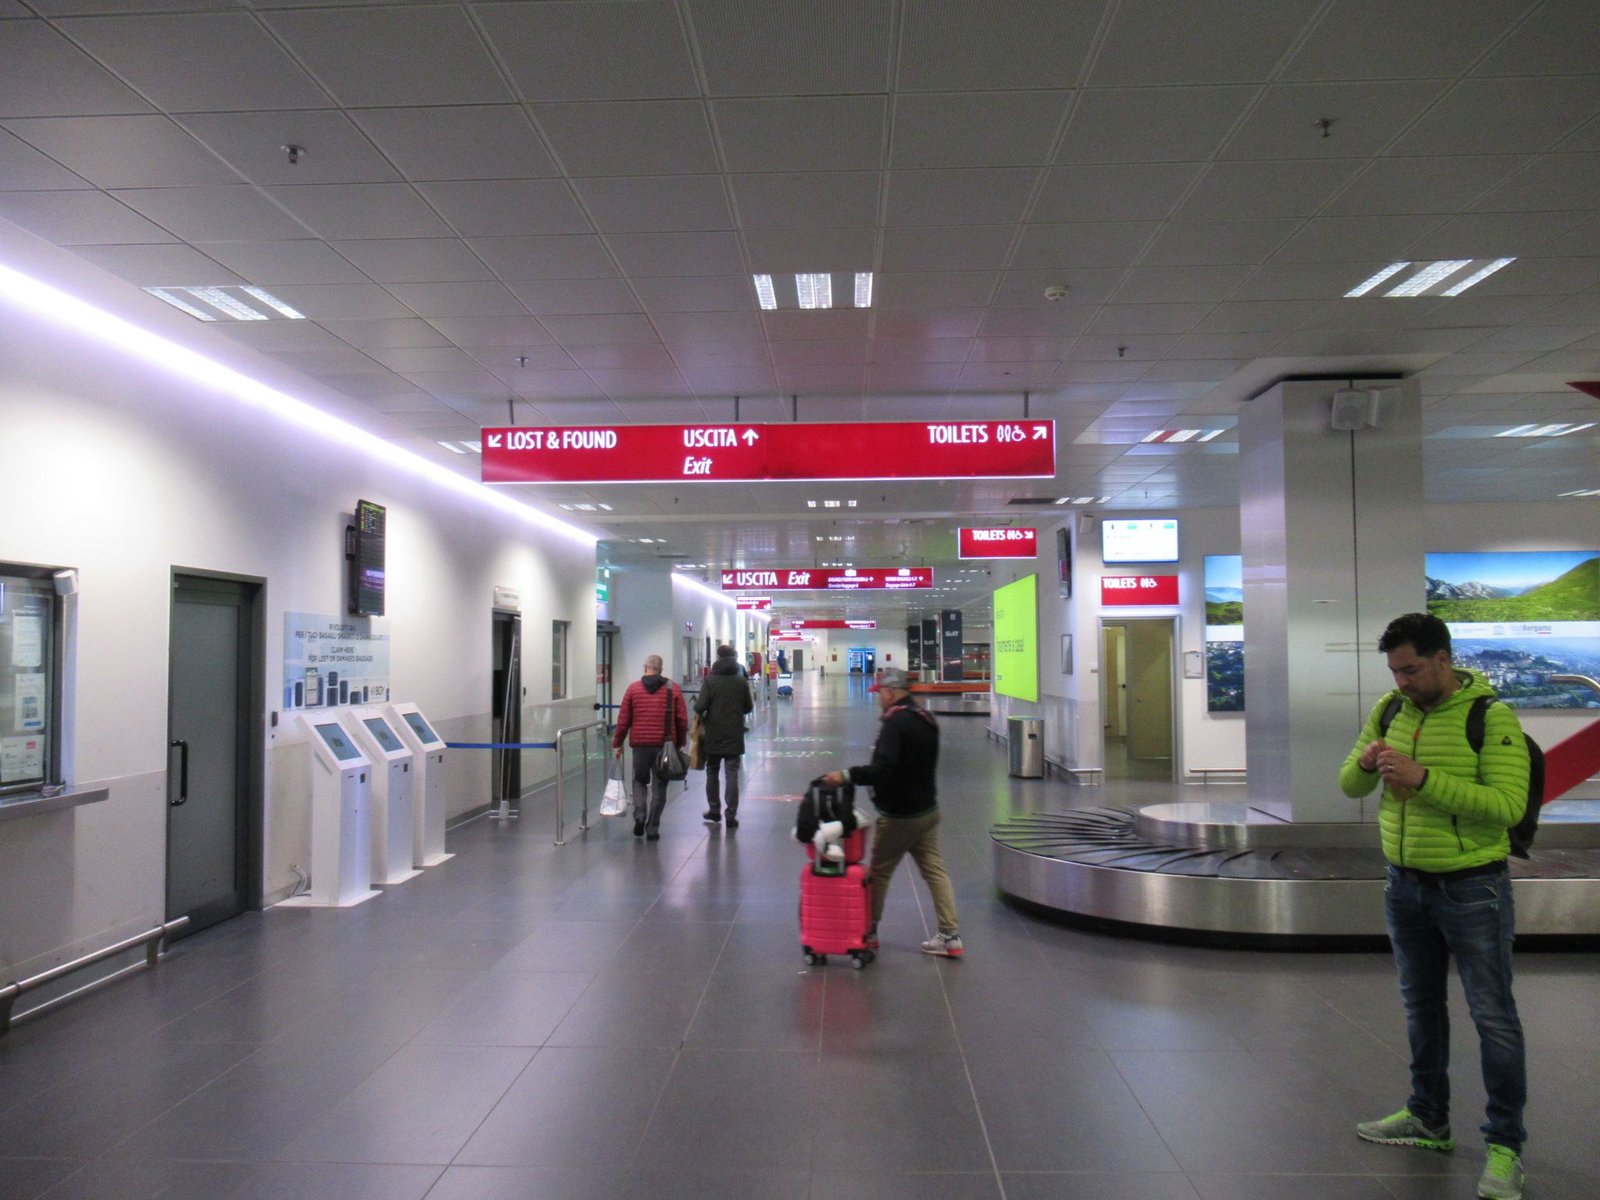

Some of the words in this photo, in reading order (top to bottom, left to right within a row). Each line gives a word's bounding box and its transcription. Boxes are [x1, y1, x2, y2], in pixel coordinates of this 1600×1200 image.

[507, 431, 544, 449] LOST
[547, 431, 559, 449] &
[563, 431, 617, 449] FOUND
[683, 429, 737, 447] USCITA
[927, 425, 989, 443] TOILETS
[683, 457, 712, 475] Exit
[972, 530, 1005, 541] TOILETS
[736, 571, 778, 586] USCITA
[788, 571, 811, 586] Exit
[1102, 578, 1137, 589] TOILETS
